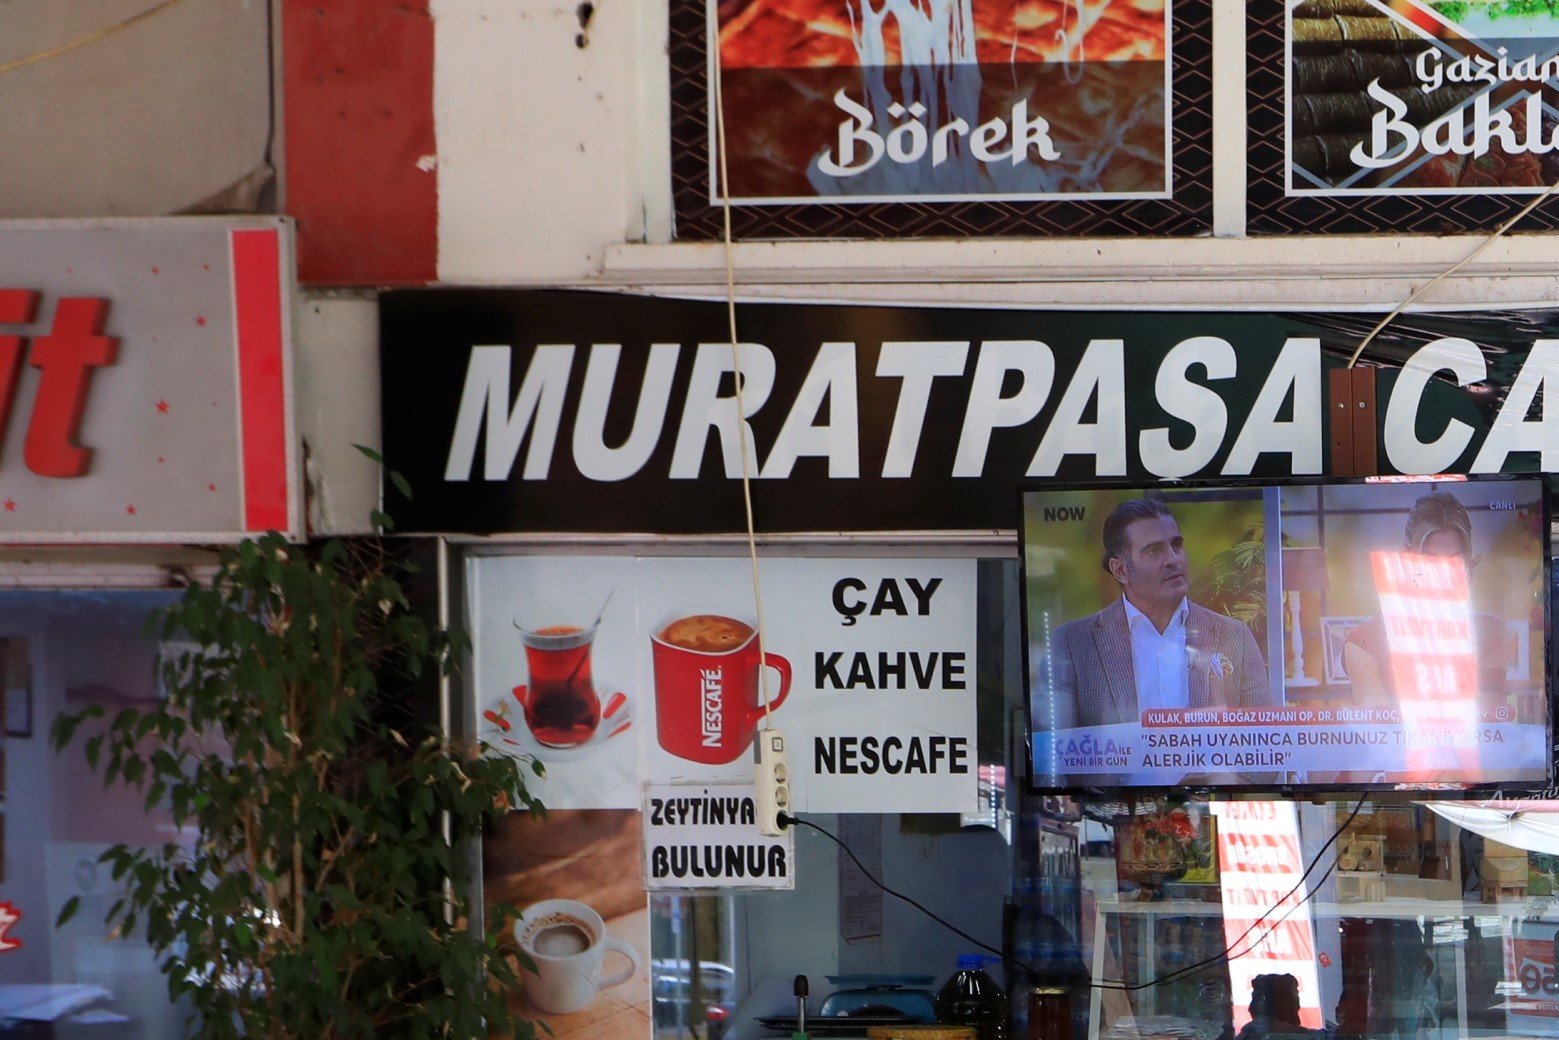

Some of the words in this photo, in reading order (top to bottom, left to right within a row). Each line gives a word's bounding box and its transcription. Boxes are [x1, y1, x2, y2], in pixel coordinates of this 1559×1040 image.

[818, 88, 1061, 176] Börek
[1044, 507, 1086, 522] NOW
[1489, 501, 1517, 510] CANLI
[832, 577, 944, 627] ÇAY
[815, 652, 967, 690] KAHVE
[1148, 712, 1183, 725] KULAK,
[1184, 712, 1220, 725] BURUN,
[1222, 708, 1257, 723] BOĞAZ
[1259, 711, 1297, 723] UZMANI
[1299, 710, 1316, 722] OP.
[1318, 710, 1335, 721] DR.
[1336, 707, 1375, 721] BÜLENT
[1055, 734, 1119, 760] ÇAĞLA
[1206, 733, 1292, 746] UYANINCA
[1297, 731, 1388, 746] BURNUNUZ
[815, 736, 968, 775] NESCAFE
[1064, 756, 1087, 767] YENİ
[1089, 757, 1103, 766] BİR
[1106, 755, 1128, 766] GÜN
[1142, 749, 1207, 767] ALERJİK
[651, 789, 756, 826] ZEYTİNYA
[652, 845, 787, 878] BULUNUR
